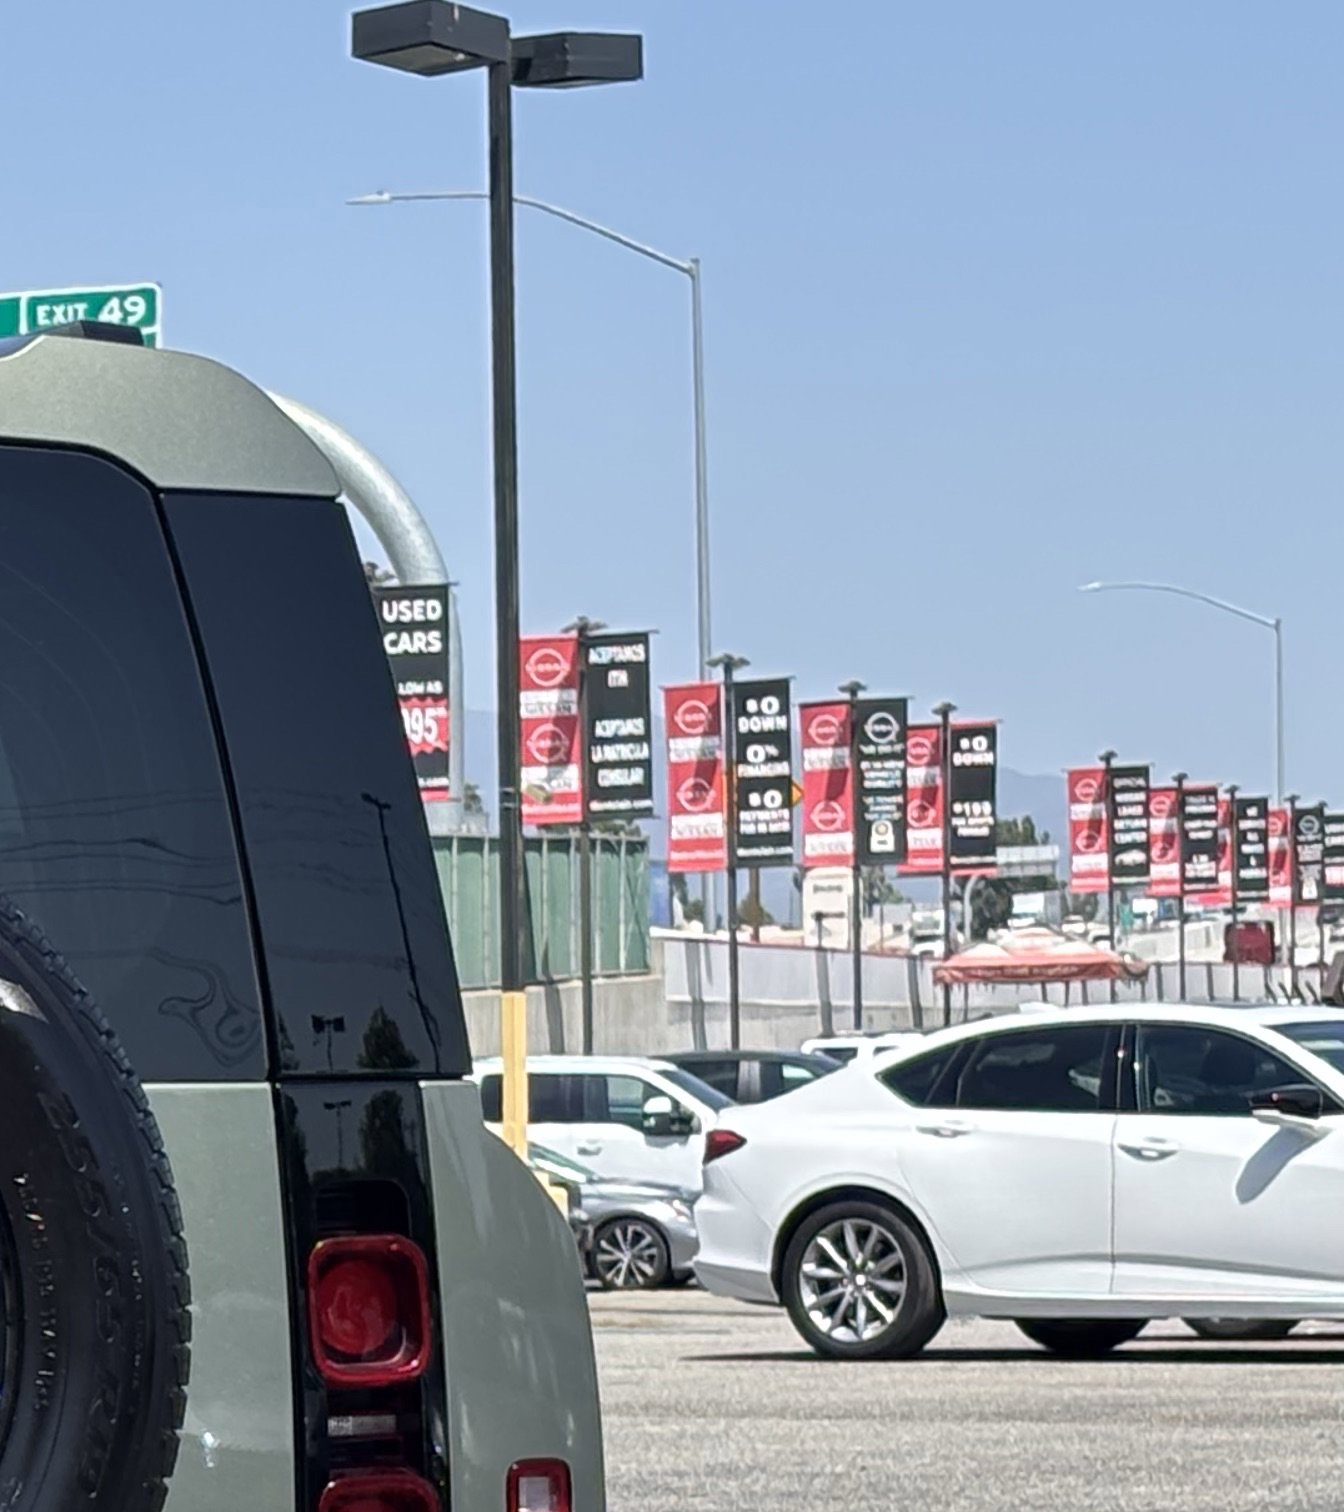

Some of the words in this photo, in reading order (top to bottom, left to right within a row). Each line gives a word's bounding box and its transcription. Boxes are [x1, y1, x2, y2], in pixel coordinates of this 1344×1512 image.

[36, 302, 88, 326] EXIT
[98, 295, 146, 326] 49
[382, 600, 442, 623] USED
[384, 631, 443, 655] CARS
[738, 715, 787, 733] DOWN
